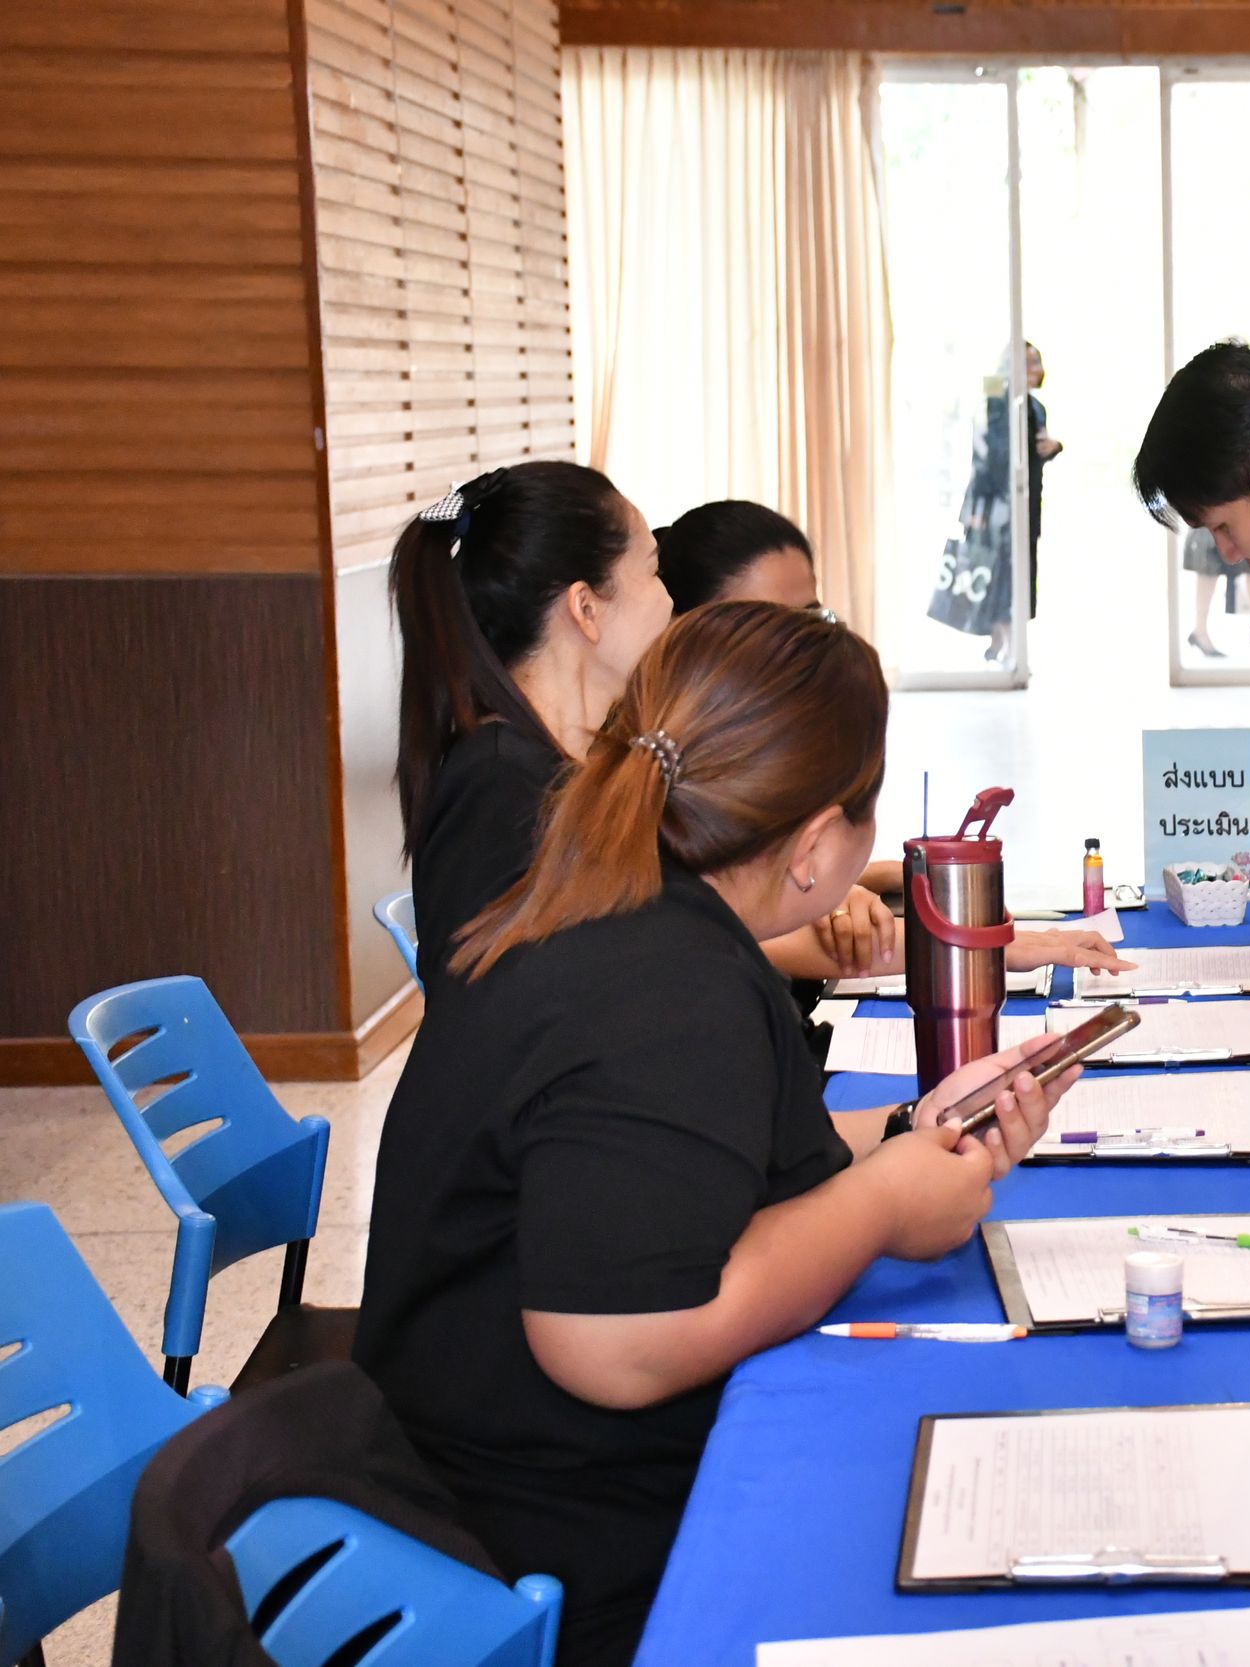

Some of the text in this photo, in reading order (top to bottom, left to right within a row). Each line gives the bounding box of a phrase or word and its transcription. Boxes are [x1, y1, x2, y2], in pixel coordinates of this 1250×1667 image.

[1162, 762, 1245, 789] ส่งแบบ
[1159, 810, 1249, 837] ประเมิน
